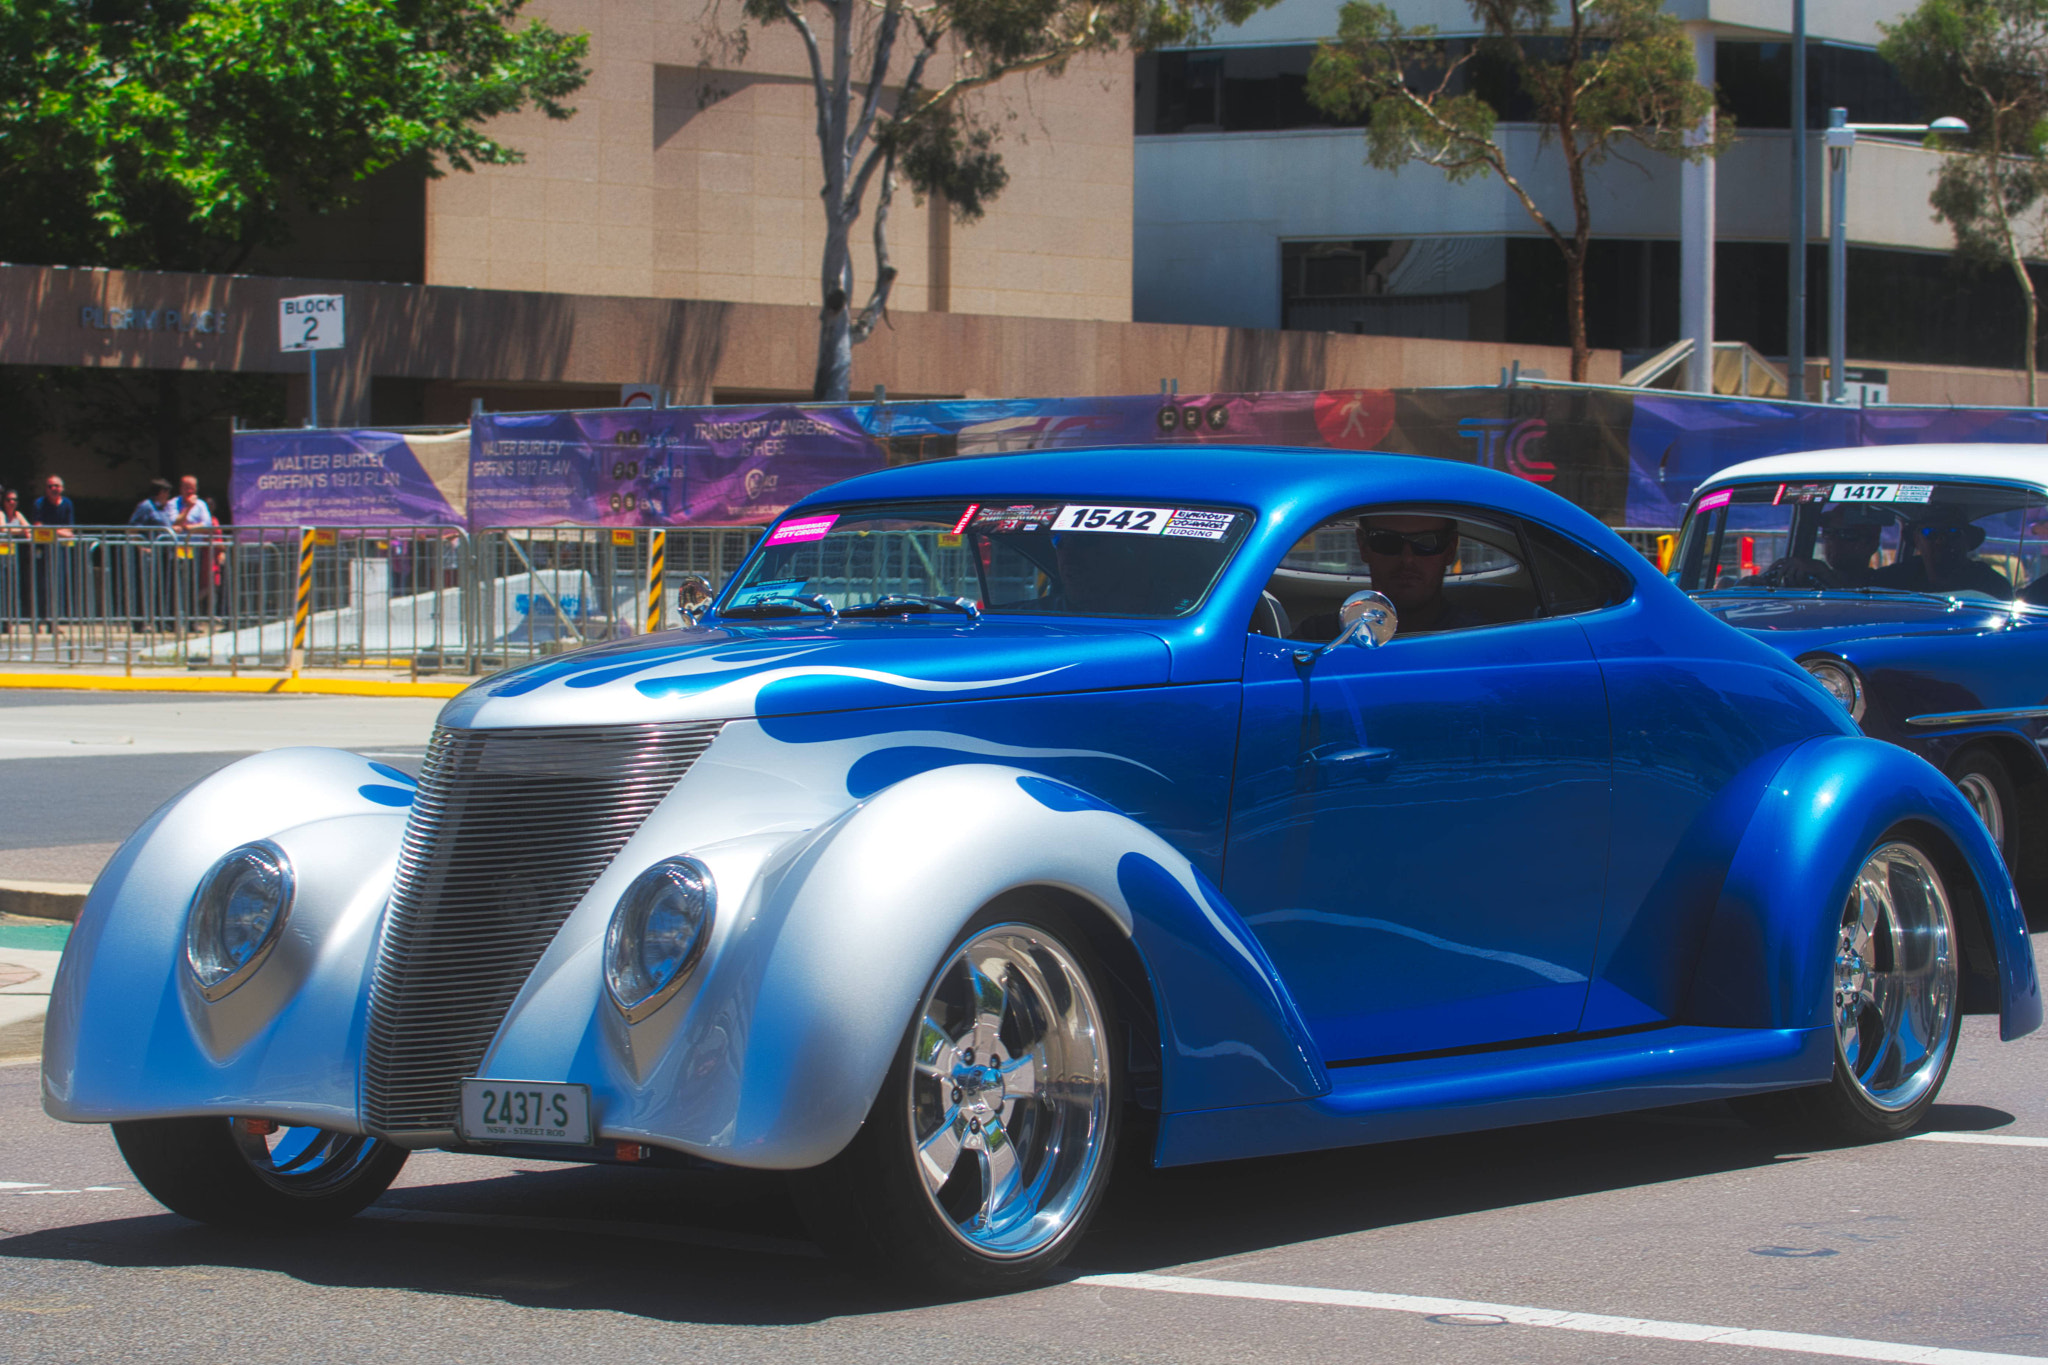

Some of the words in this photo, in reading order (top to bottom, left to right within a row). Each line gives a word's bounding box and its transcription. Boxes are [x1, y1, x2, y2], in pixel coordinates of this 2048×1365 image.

[285, 299, 336, 315] BLOCK
[304, 316, 319, 341] 2
[694, 420, 769, 440] TRANSPORT
[481, 440, 518, 456] WALTER
[519, 440, 563, 456] BURLEY
[753, 439, 786, 456] HERE
[272, 455, 330, 471] WALTER
[333, 453, 385, 469] BURLEY
[517, 460, 537, 476] 1912
[540, 459, 571, 475] PLAN
[257, 473, 328, 490] GRIFFIN'S
[331, 472, 361, 487] 1912
[364, 472, 400, 486] PLAN
[1843, 485, 1889, 500] 1417
[953, 505, 977, 535] ENTRANT
[1072, 508, 1157, 531] 1542
[773, 530, 795, 540] CITY
[1168, 528, 1213, 538] JUDGING
[487, 1126, 506, 1134] NSW
[513, 1127, 544, 1136] STREET
[546, 1129, 566, 1137] ROD
